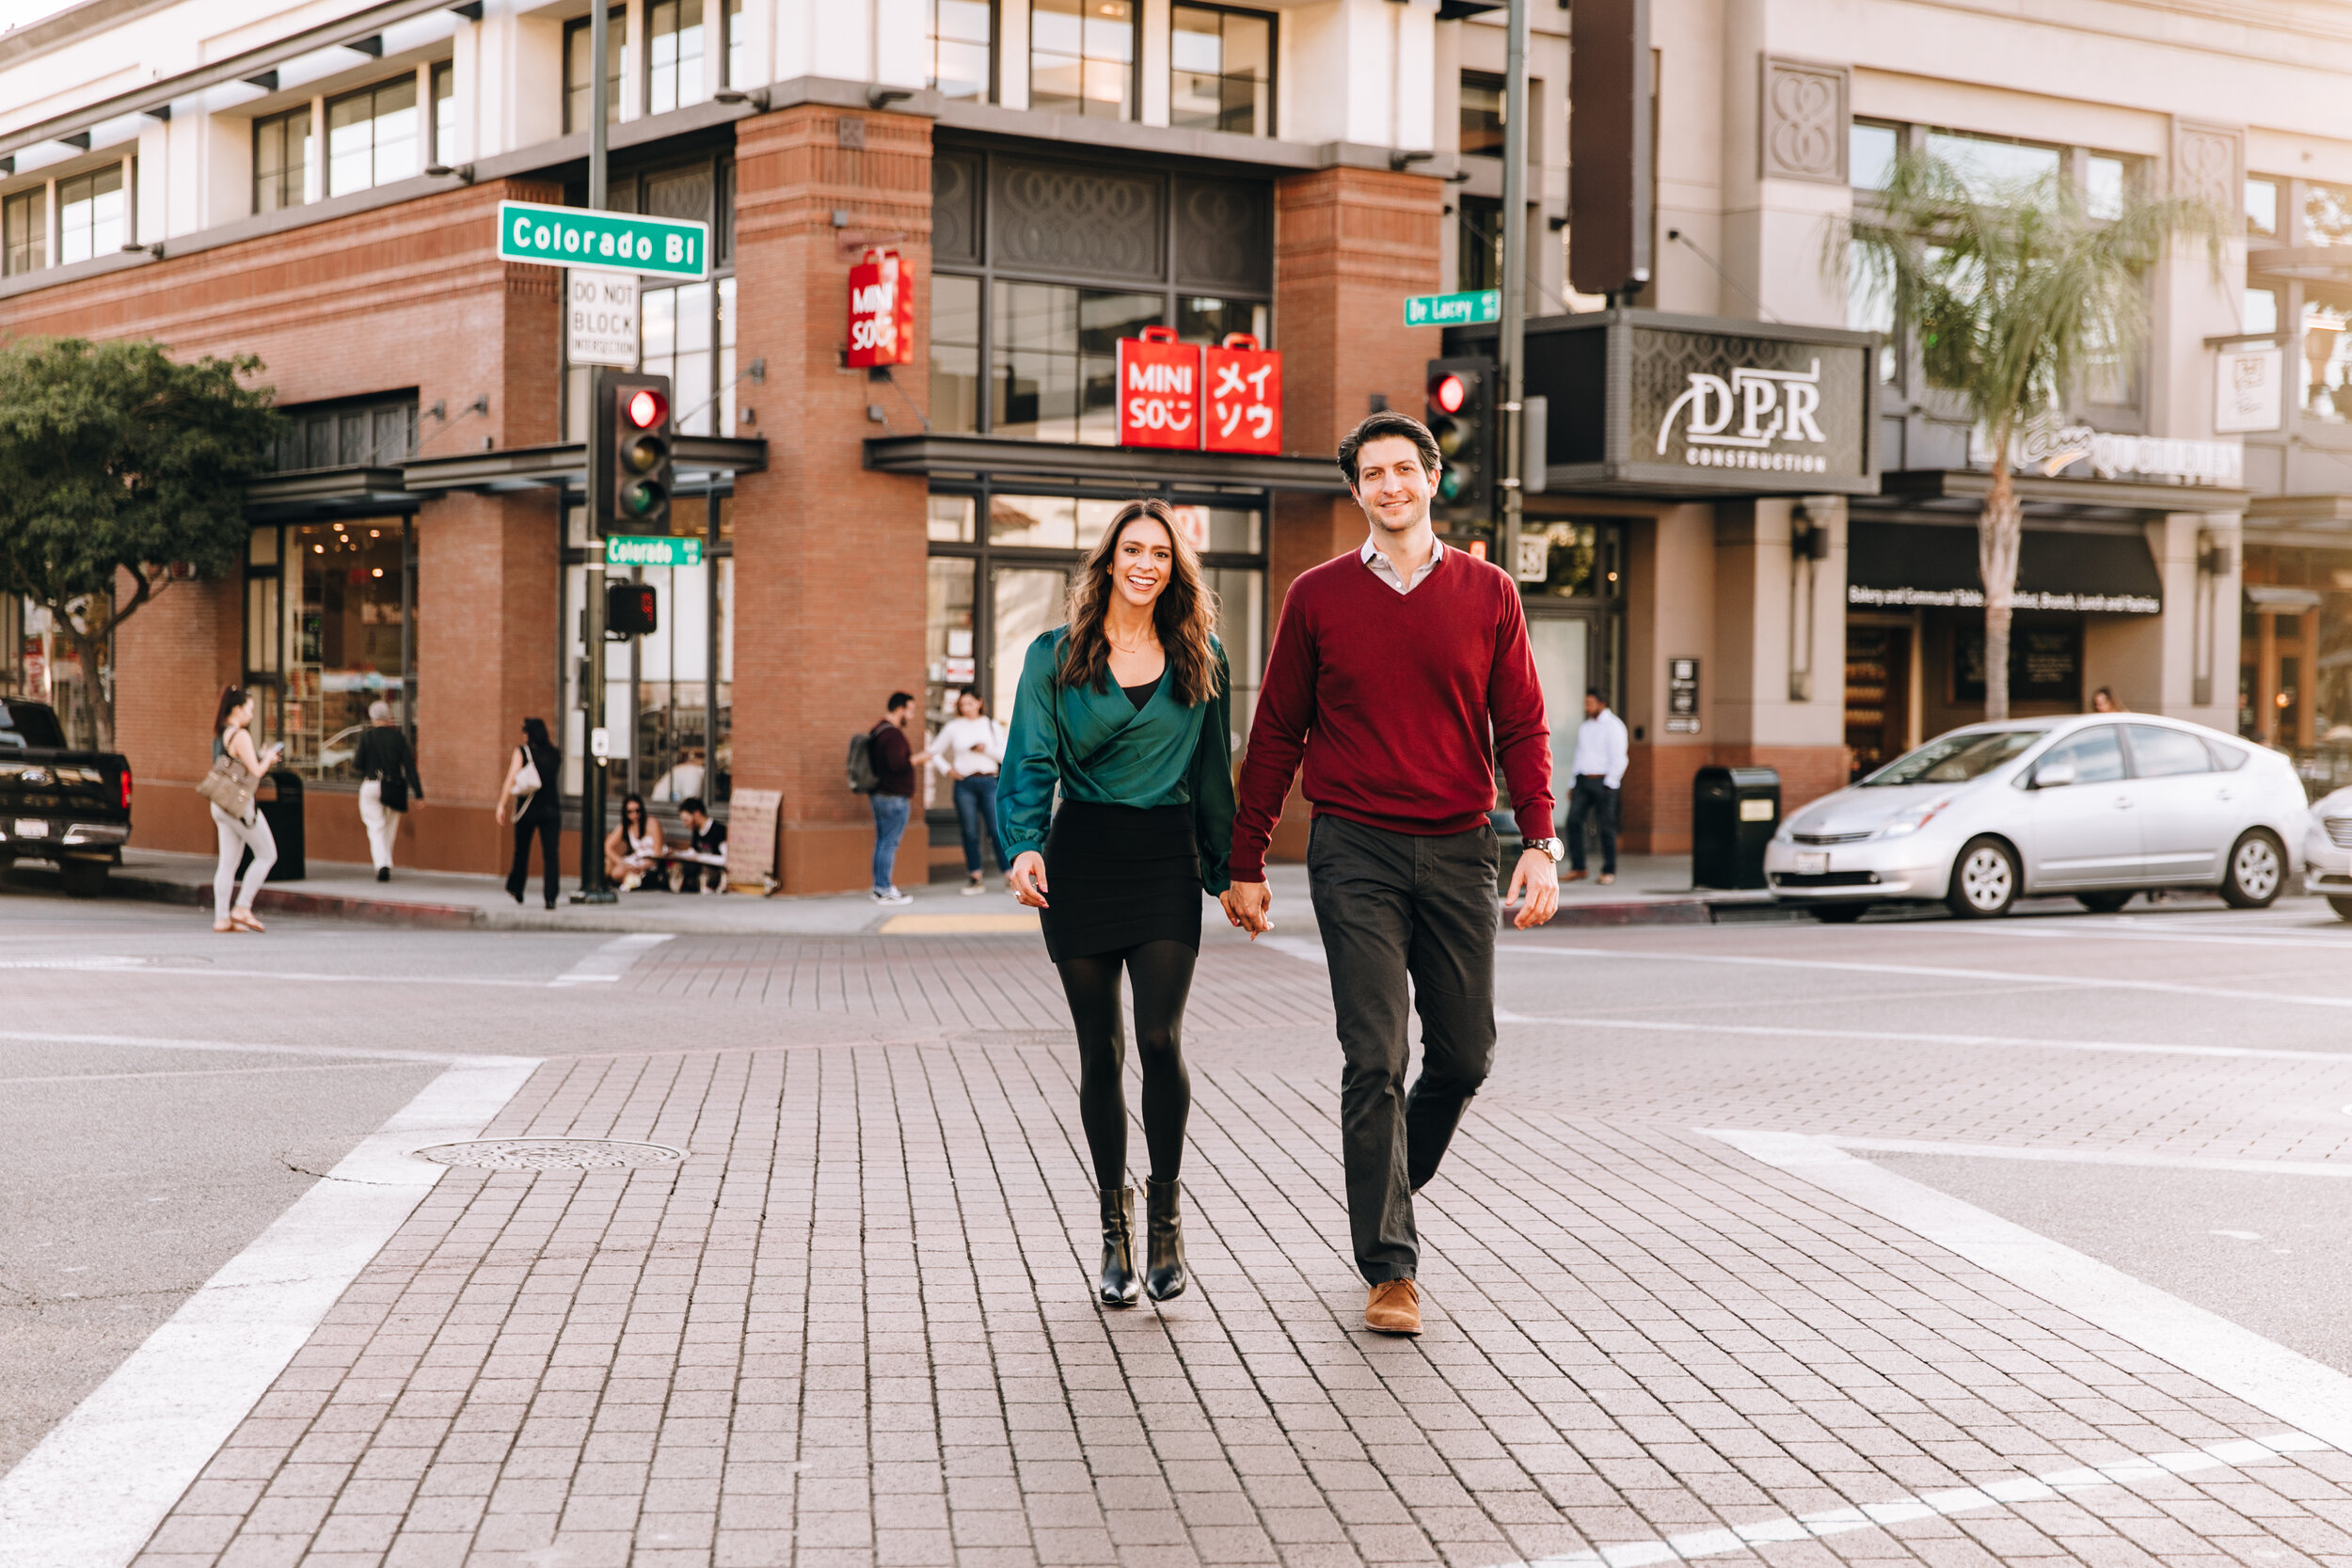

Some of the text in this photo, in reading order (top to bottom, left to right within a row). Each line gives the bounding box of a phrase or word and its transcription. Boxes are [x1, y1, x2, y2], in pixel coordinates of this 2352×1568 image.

[513, 216, 694, 265] Colorado Bl
[574, 281, 633, 307] DO NOT
[574, 311, 633, 335] BLOCK
[572, 339, 635, 356] INTERSECTION
[1129, 361, 1192, 395] MINI
[1213, 361, 1272, 402] メイ
[1683, 368, 1827, 444] DPR
[1215, 403, 1273, 439] ソウ
[1685, 447, 1827, 473] CONSTRUCTION
[608, 536, 674, 564] Colorado
[1884, 586, 1905, 605] and
